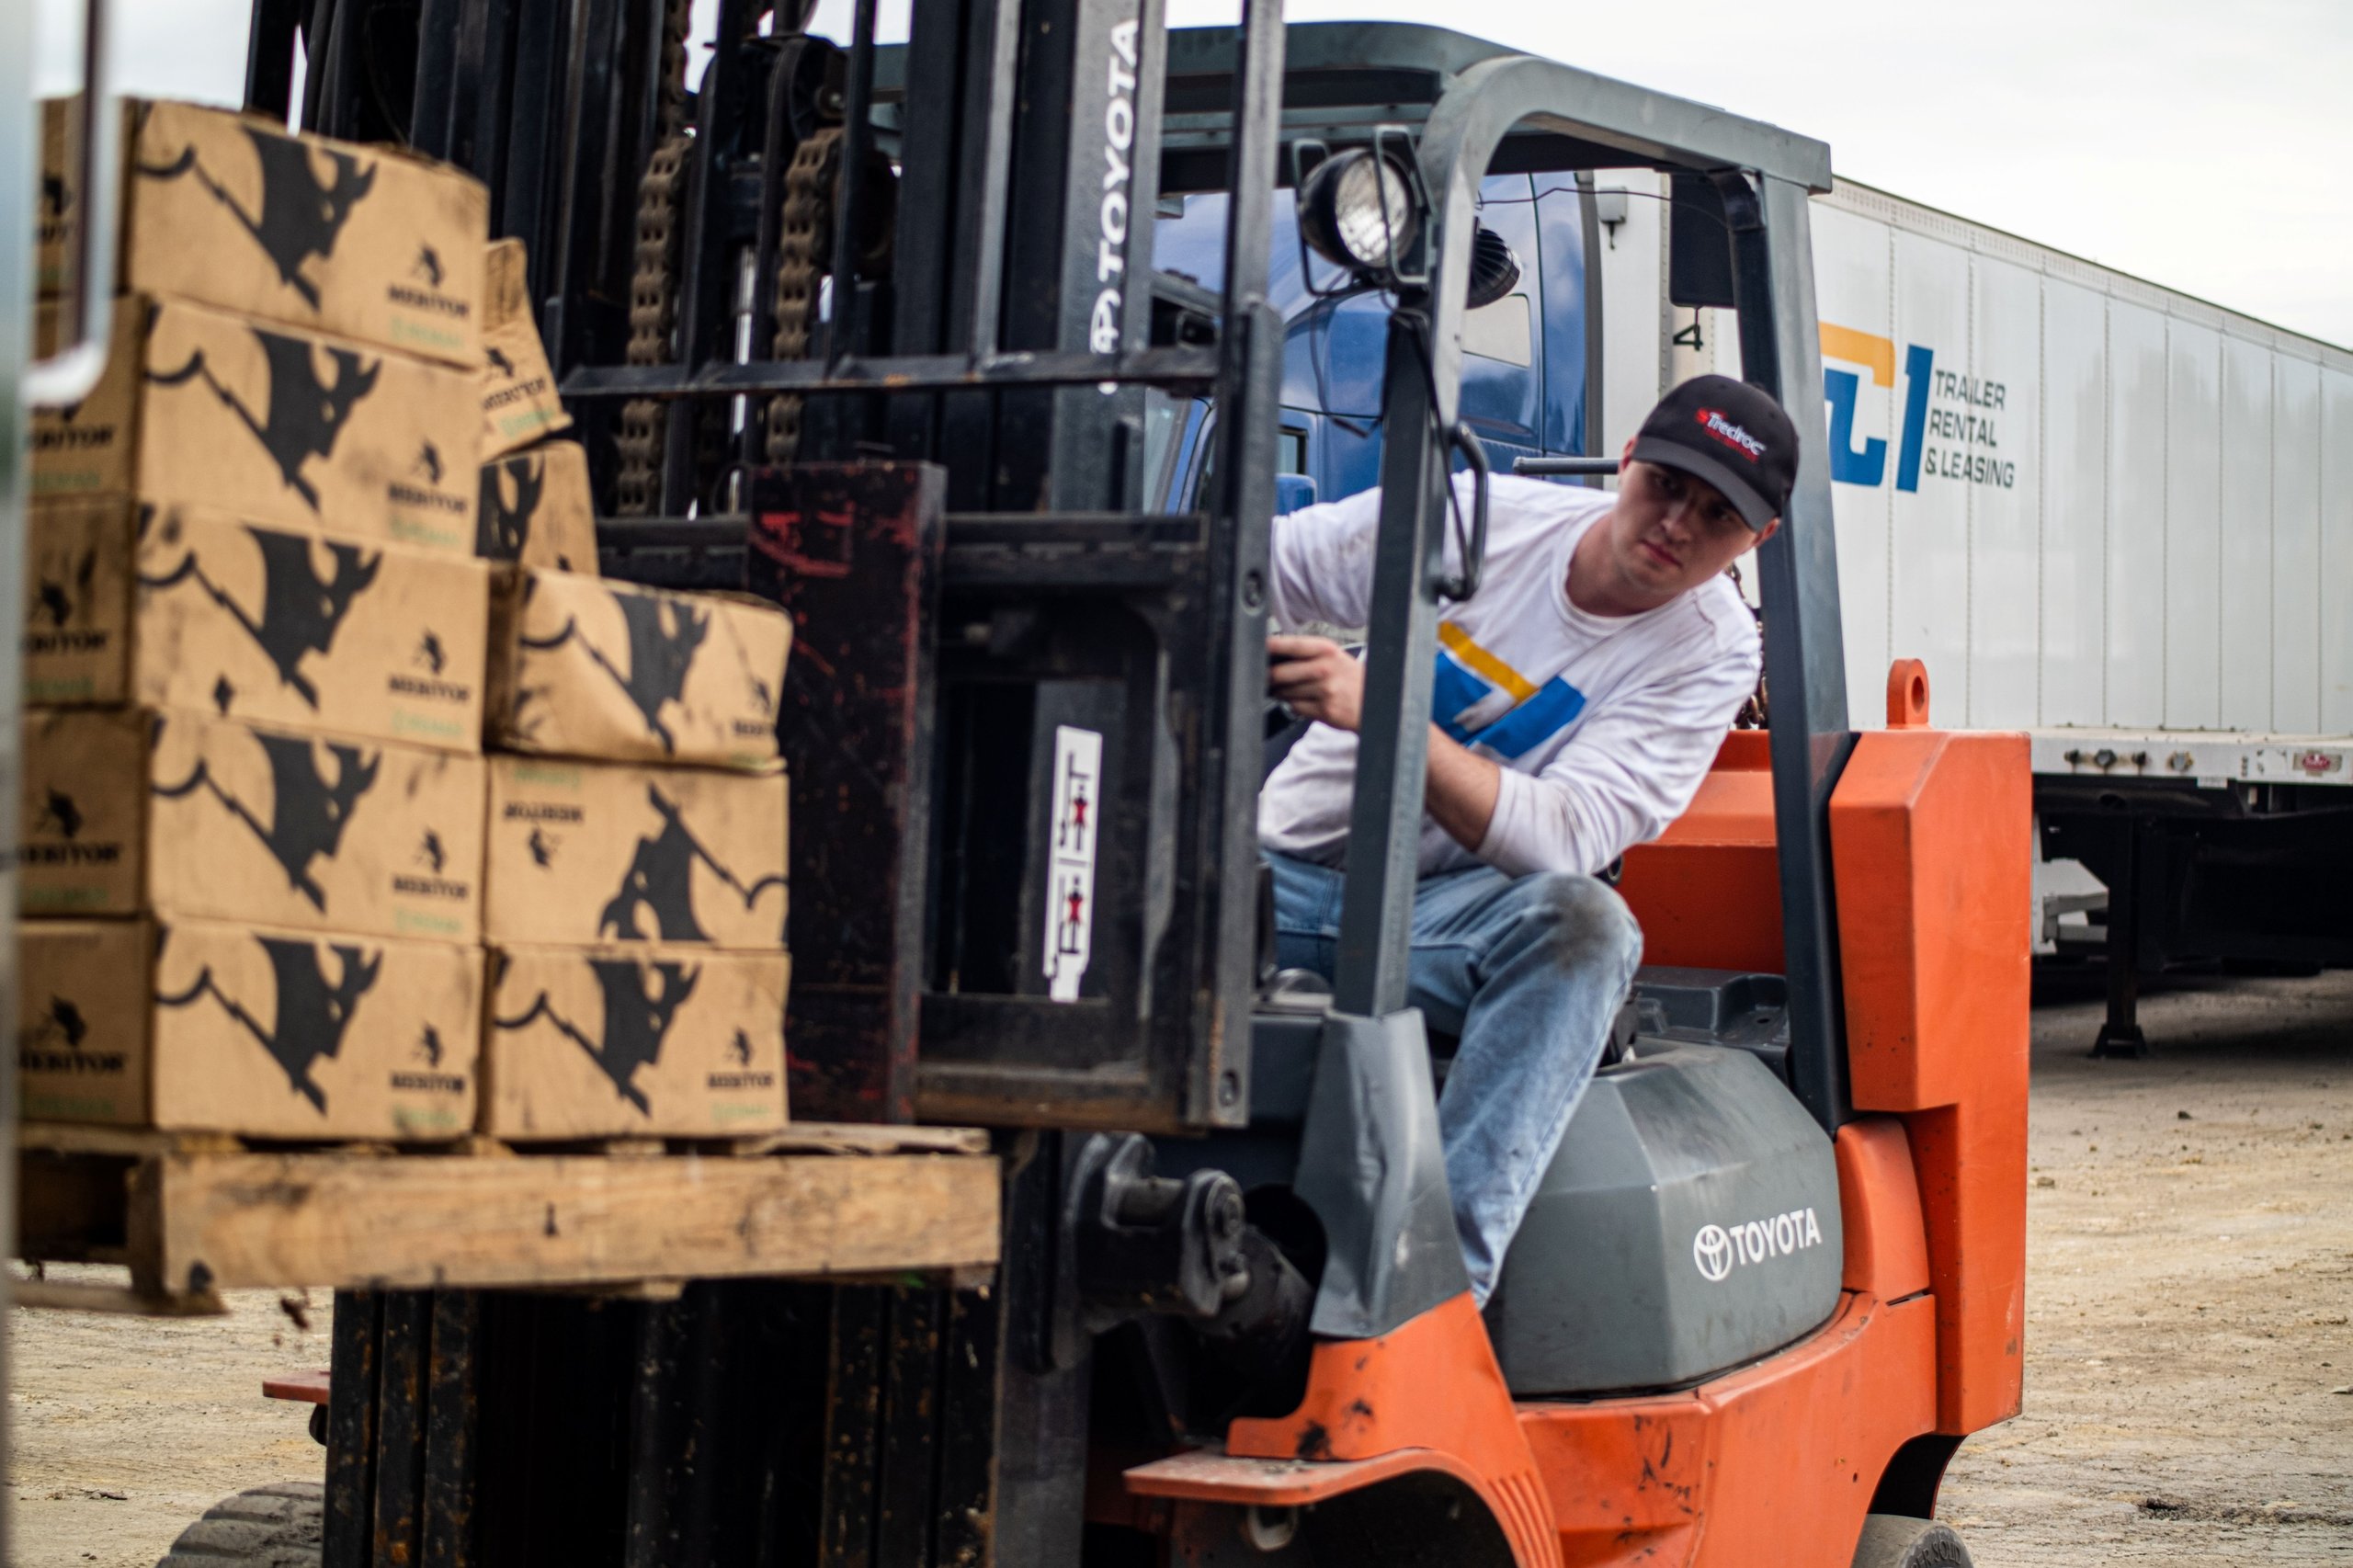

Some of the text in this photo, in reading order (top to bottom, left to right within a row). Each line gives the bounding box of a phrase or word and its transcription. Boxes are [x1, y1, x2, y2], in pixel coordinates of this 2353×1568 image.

[1096, 18, 1141, 283] TOYOTA
[1672, 323, 1704, 352] 4
[1935, 369, 2006, 411] TRAILER
[1707, 411, 1767, 456] Tredroc
[1928, 408, 1997, 449] RENTAL
[1924, 447, 2016, 490] & LEASING
[1729, 1207, 1823, 1266] TOYOTA
